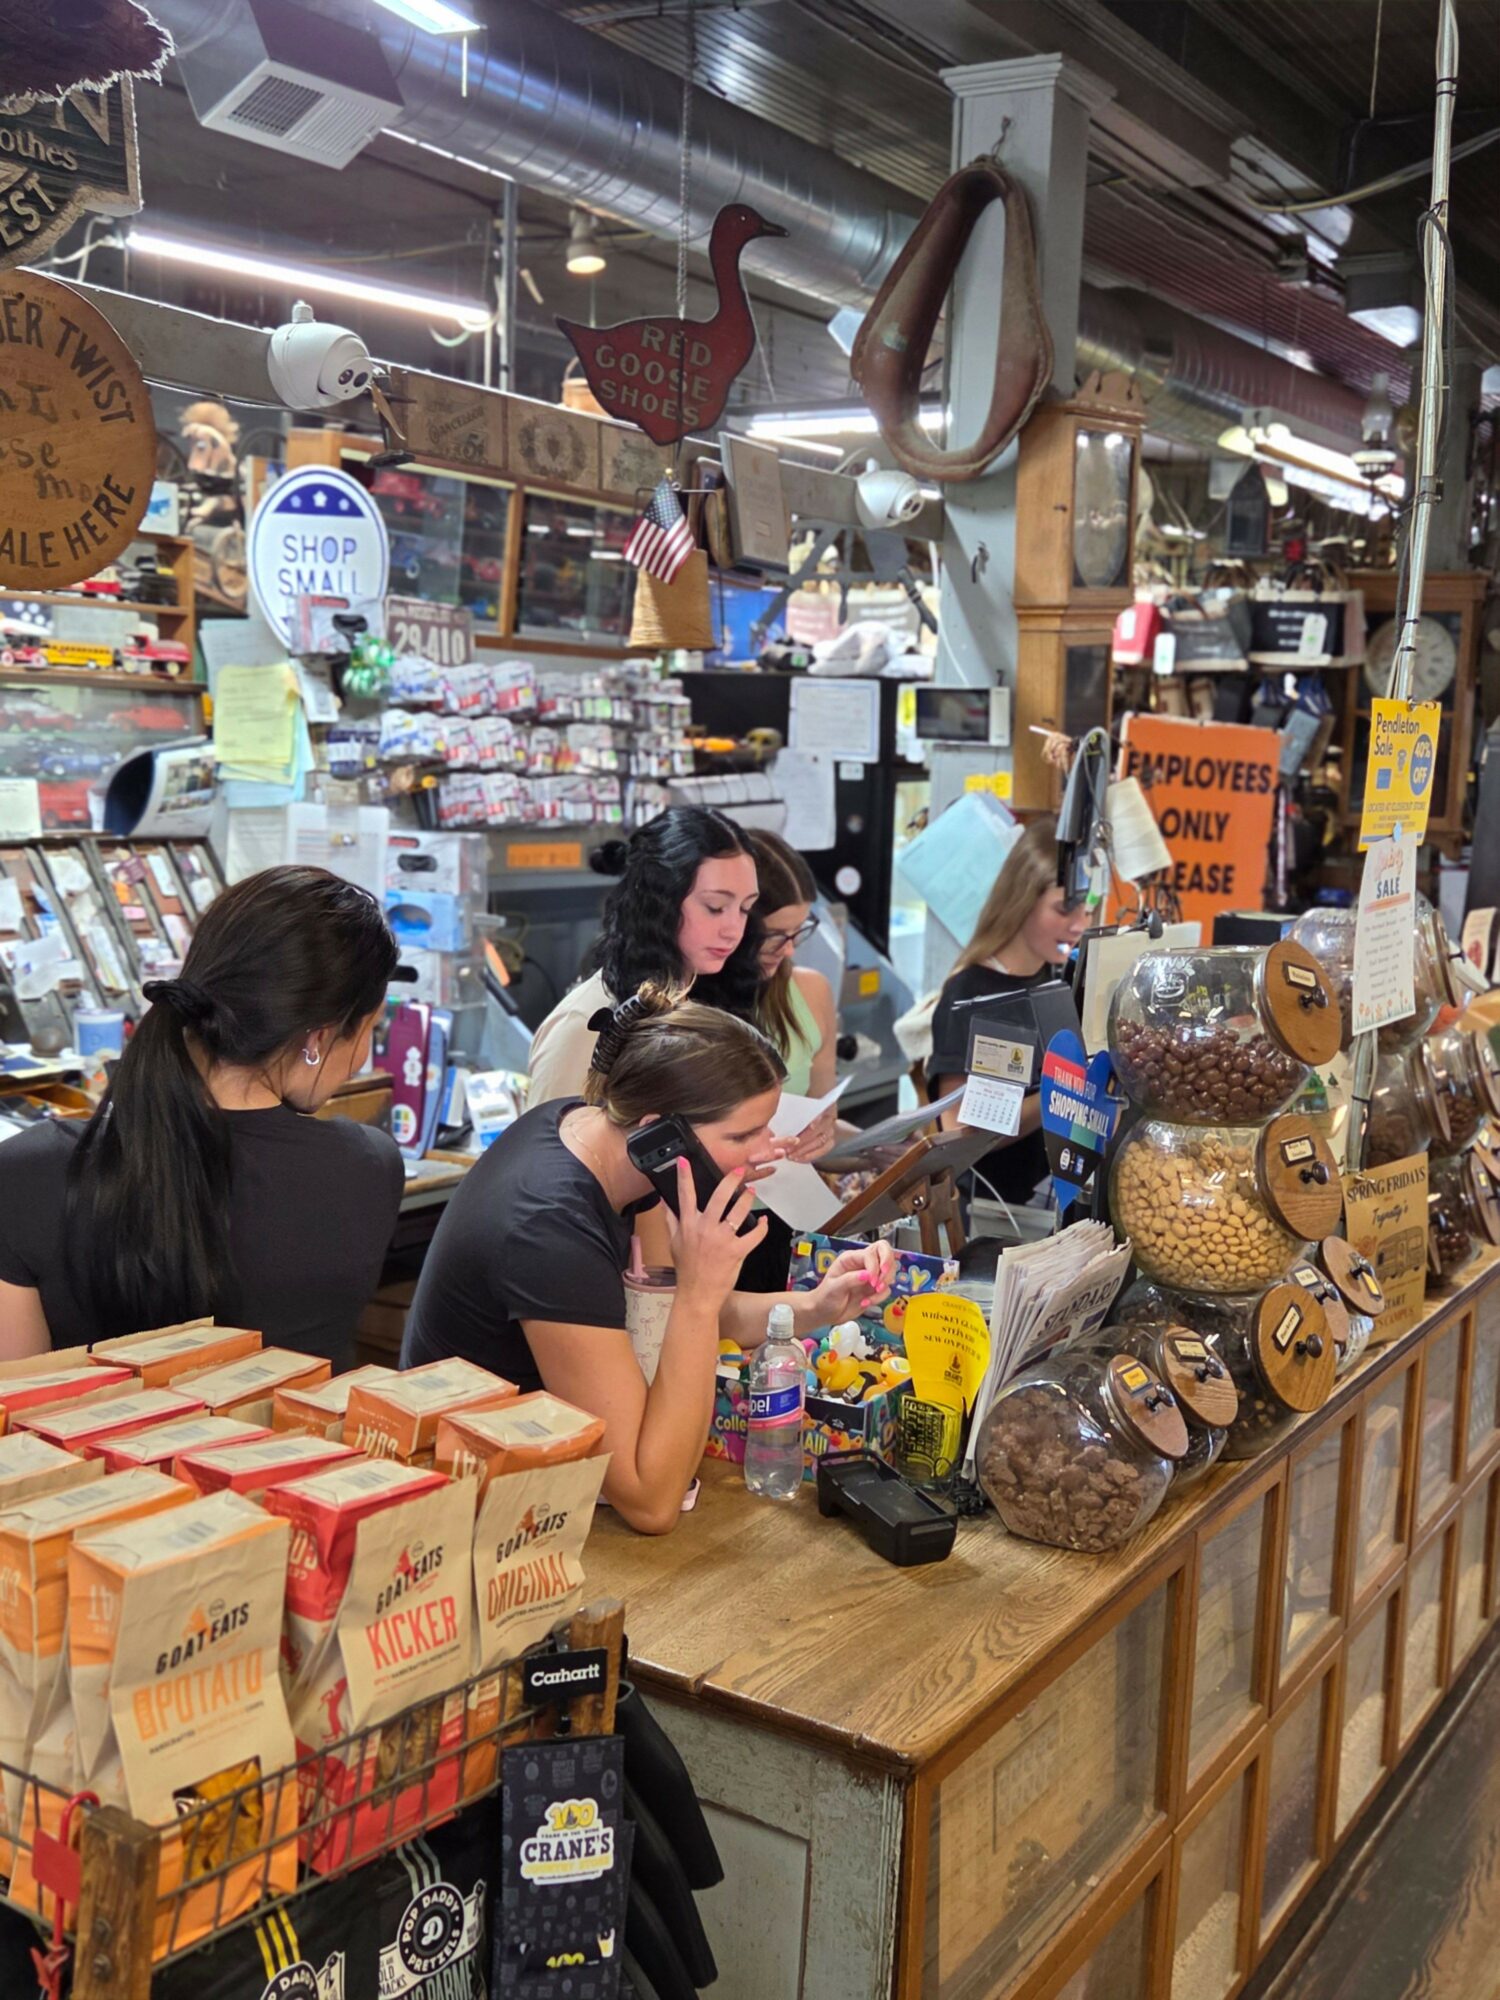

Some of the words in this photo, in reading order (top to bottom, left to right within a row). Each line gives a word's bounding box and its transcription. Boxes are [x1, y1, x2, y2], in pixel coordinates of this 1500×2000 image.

[0, 298, 44, 349] ER
[54, 315, 136, 424] TWIST
[641, 324, 712, 367] RED
[595, 344, 711, 402] GOOSE
[600, 379, 699, 427] SHOES
[63, 473, 135, 561] HERE
[283, 534, 357, 564] SHOP
[278, 568, 364, 597] SMALL
[1376, 712, 1420, 735] Pendleton
[1374, 735, 1393, 756] Sale
[1127, 751, 1273, 794] EMPLOYEES
[1412, 766, 1428, 784] OFF
[1160, 807, 1231, 842] ONLY
[1157, 860, 1235, 895] LEASE
[1376, 877, 1400, 899] SALE
[1054, 1065, 1074, 1091] THANK
[1073, 1075, 1085, 1097] YOU
[1084, 1080, 1097, 1102] FOR
[1049, 1090, 1089, 1127] SHOPPING
[1087, 1107, 1110, 1137] SMALL
[1346, 1181, 1385, 1204] SPRING
[1386, 1165, 1426, 1195] FRIDAYS
[923, 1334, 942, 1344] SEW
[496, 1527, 531, 1563] GOAT
[532, 1511, 568, 1539] EATS
[376, 1567, 411, 1614] GOAT
[413, 1545, 443, 1582] EATS
[487, 1551, 577, 1622] ORIGINAL
[155, 1628, 207, 1675] GOAT
[209, 1602, 249, 1644] EATS
[365, 1595, 458, 1670] KICKER
[155, 1647, 262, 1731] POTATO
[531, 1663, 600, 1687] Carhartt
[524, 1832, 611, 1863] CRANE'S
[402, 1907, 419, 1943] POP
[422, 1889, 460, 1913] DADDY
[407, 1929, 460, 1972] PRETZELS
